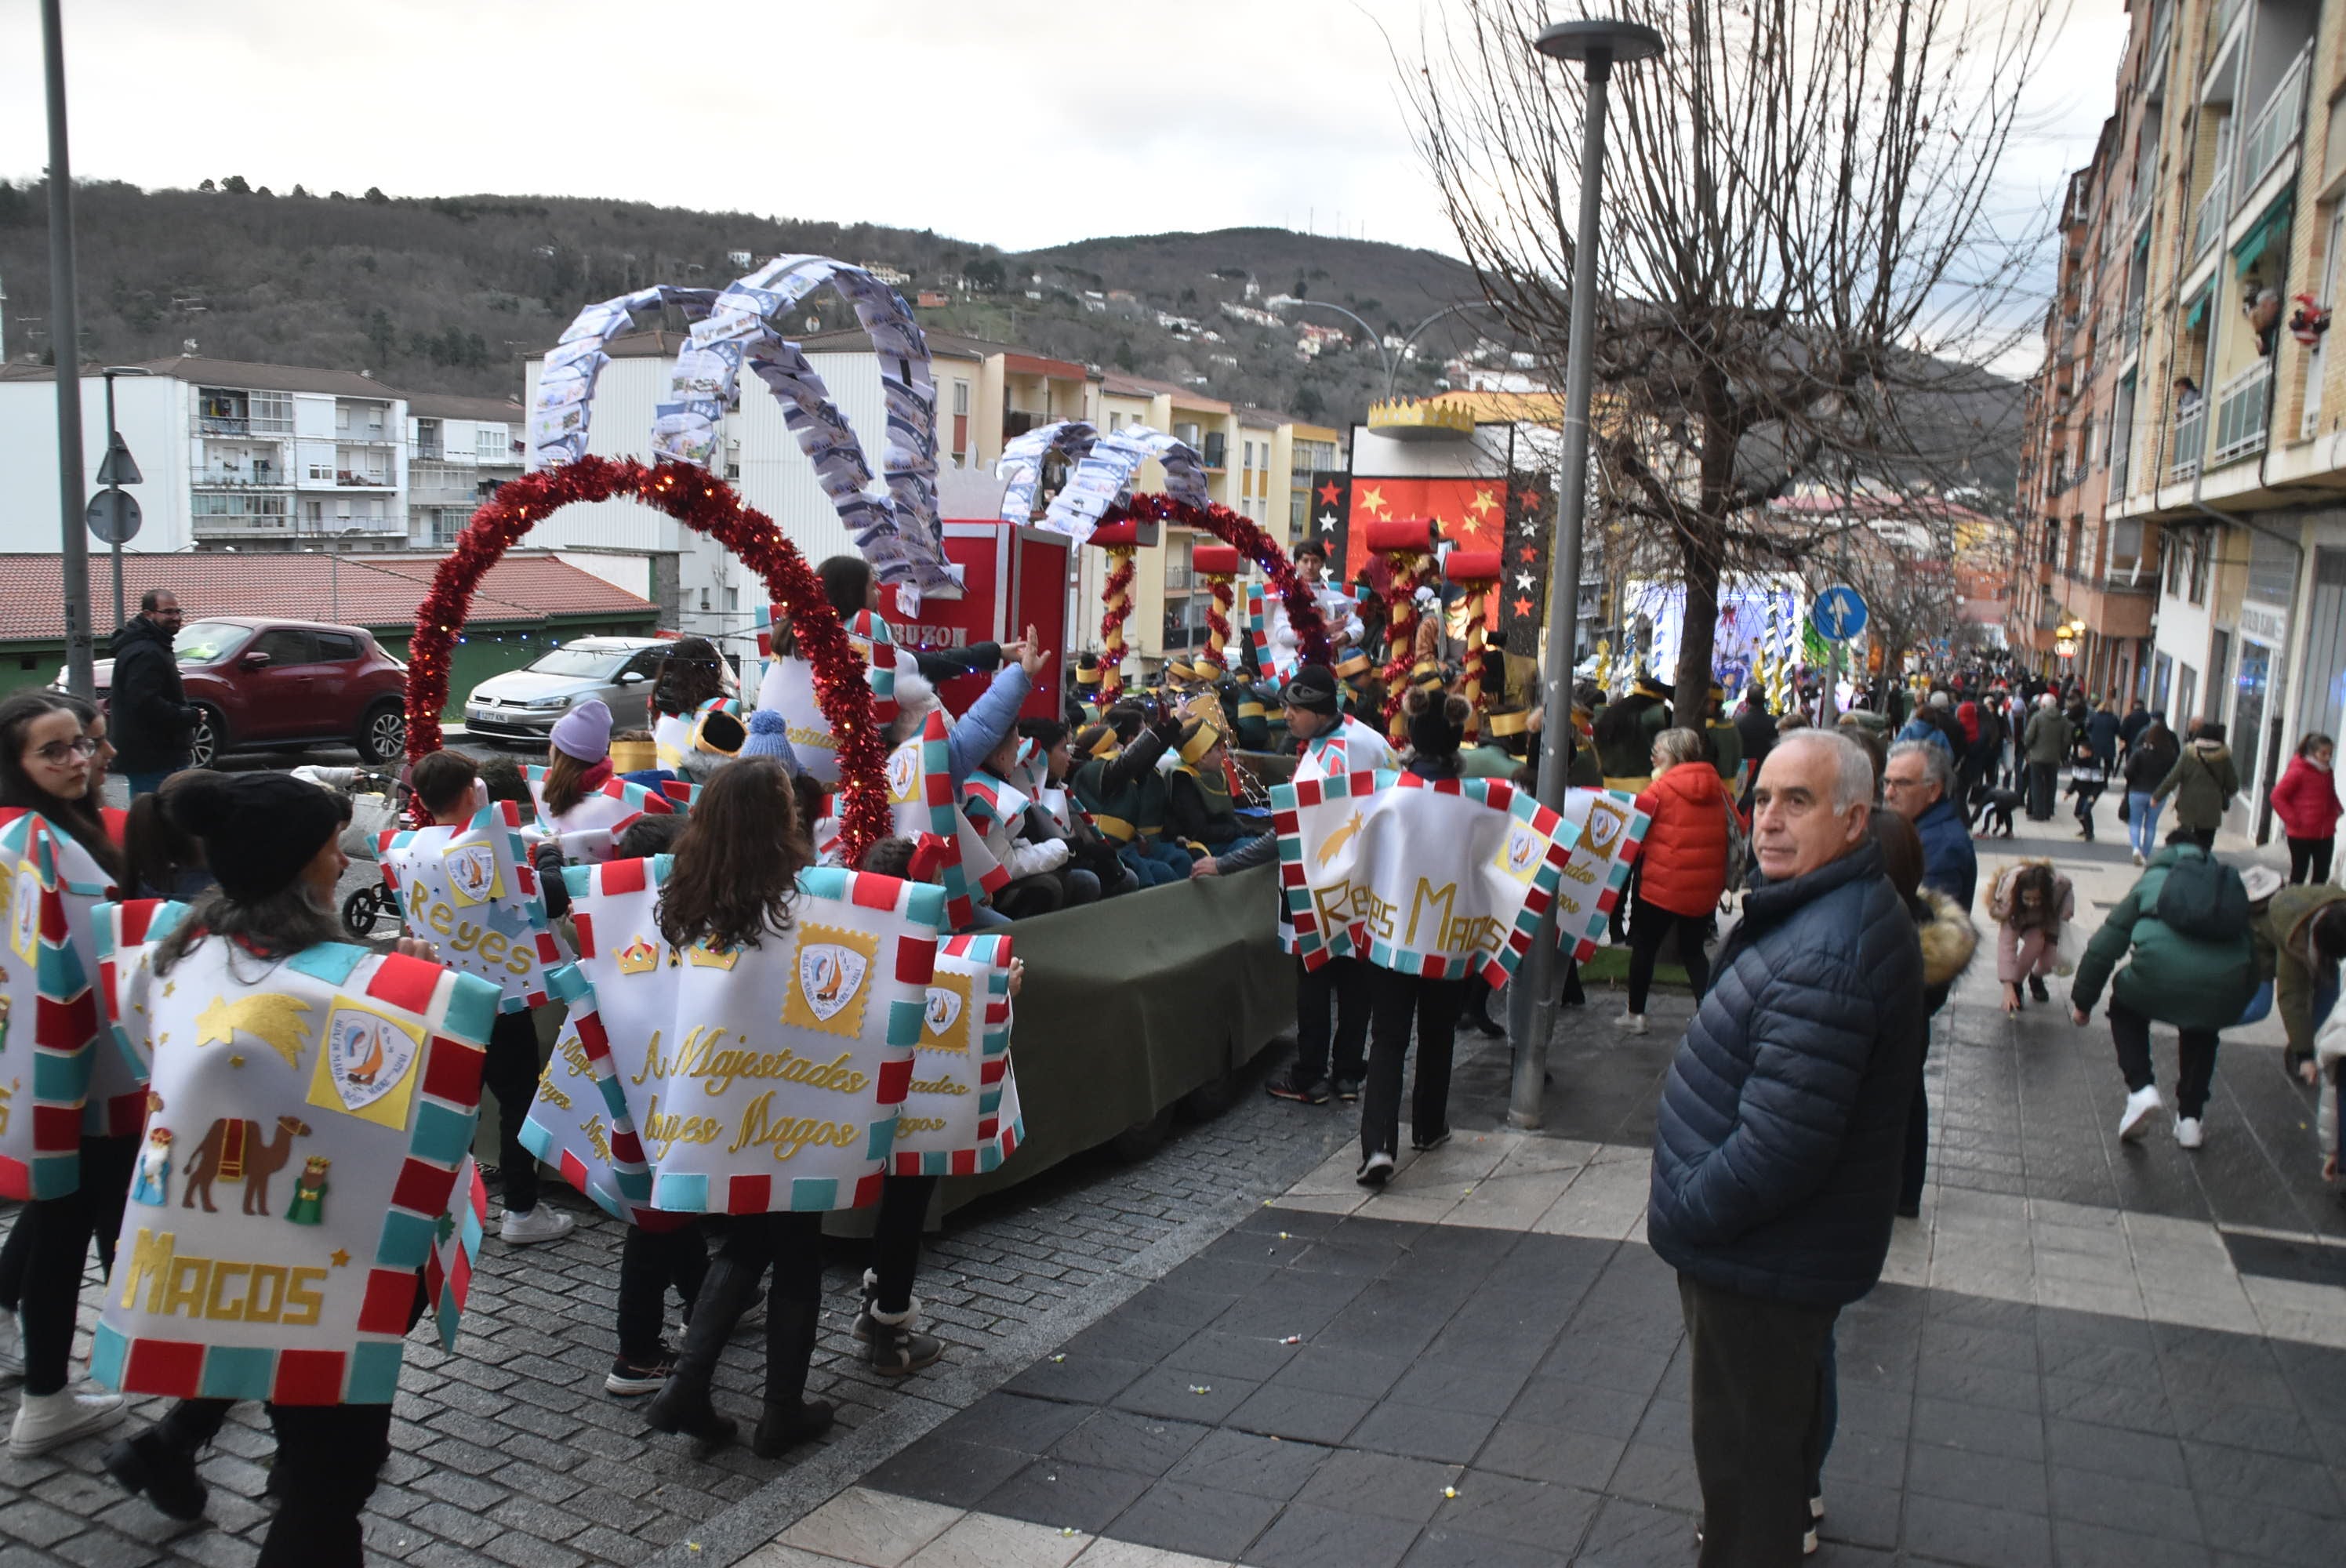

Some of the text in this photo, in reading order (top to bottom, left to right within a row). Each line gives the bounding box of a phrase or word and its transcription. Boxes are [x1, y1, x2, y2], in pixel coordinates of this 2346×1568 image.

[890, 622, 968, 648] BUZON
[409, 879, 536, 975] Reyes
[1313, 878, 1398, 941] Rees
[670, 1025, 870, 1096] Majestades
[728, 1090, 862, 1162] Magos
